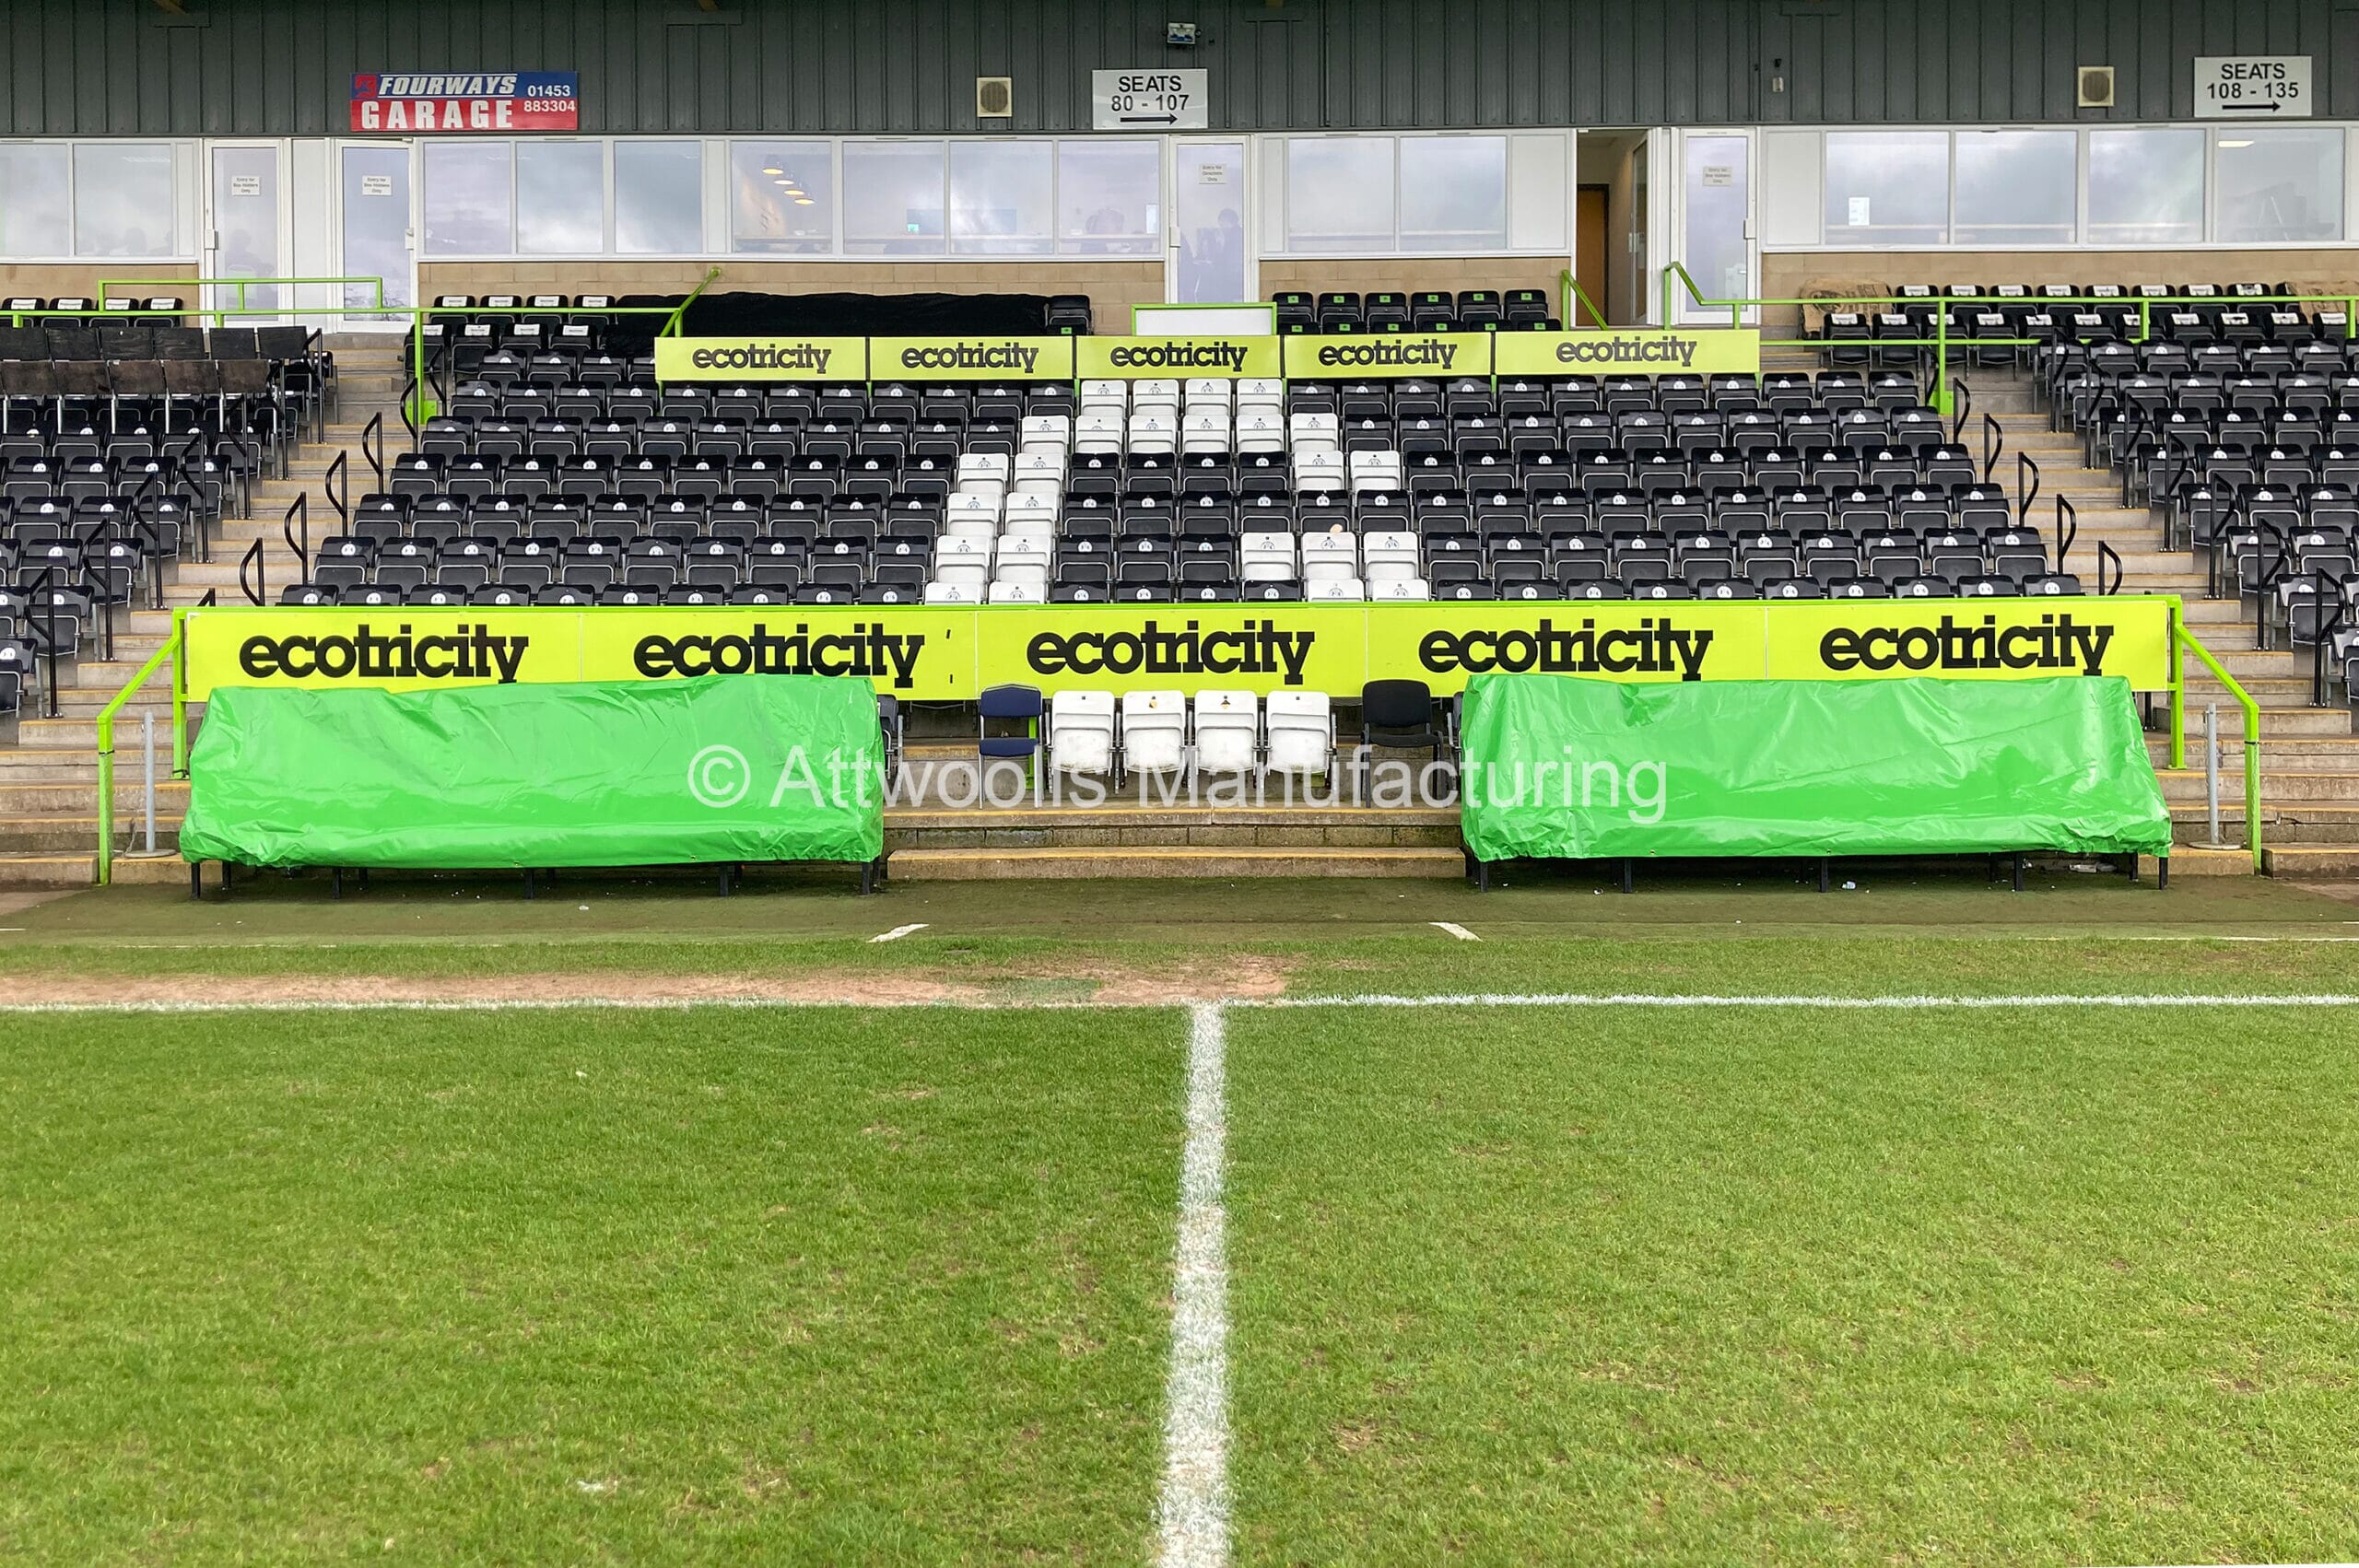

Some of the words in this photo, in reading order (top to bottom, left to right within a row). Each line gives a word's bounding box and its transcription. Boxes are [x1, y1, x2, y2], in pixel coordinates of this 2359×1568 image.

[378, 76, 518, 95] FOURWAYS
[1119, 76, 1181, 93] SEATS
[2221, 63, 2285, 80] SEATS
[527, 85, 570, 97] 01453
[1111, 95, 1133, 111] 80
[1156, 94, 1190, 111] 107
[2207, 82, 2242, 99] 108
[2264, 81, 2299, 99] 135
[361, 100, 513, 130] GARAGE
[523, 100, 576, 111] 883304
[693, 345, 830, 373] ecotricity
[902, 343, 1039, 373] ecotricity
[1111, 342, 1248, 371] ecotricity
[1319, 339, 1457, 369] ecotricity
[1557, 336, 1695, 367] ecotricity
[240, 624, 528, 684] ecotricity
[634, 624, 924, 688] ecotricity
[1027, 620, 1314, 685] ecotricity
[1419, 618, 1714, 681] ecotricity
[1820, 614, 2114, 676] ecotricity
